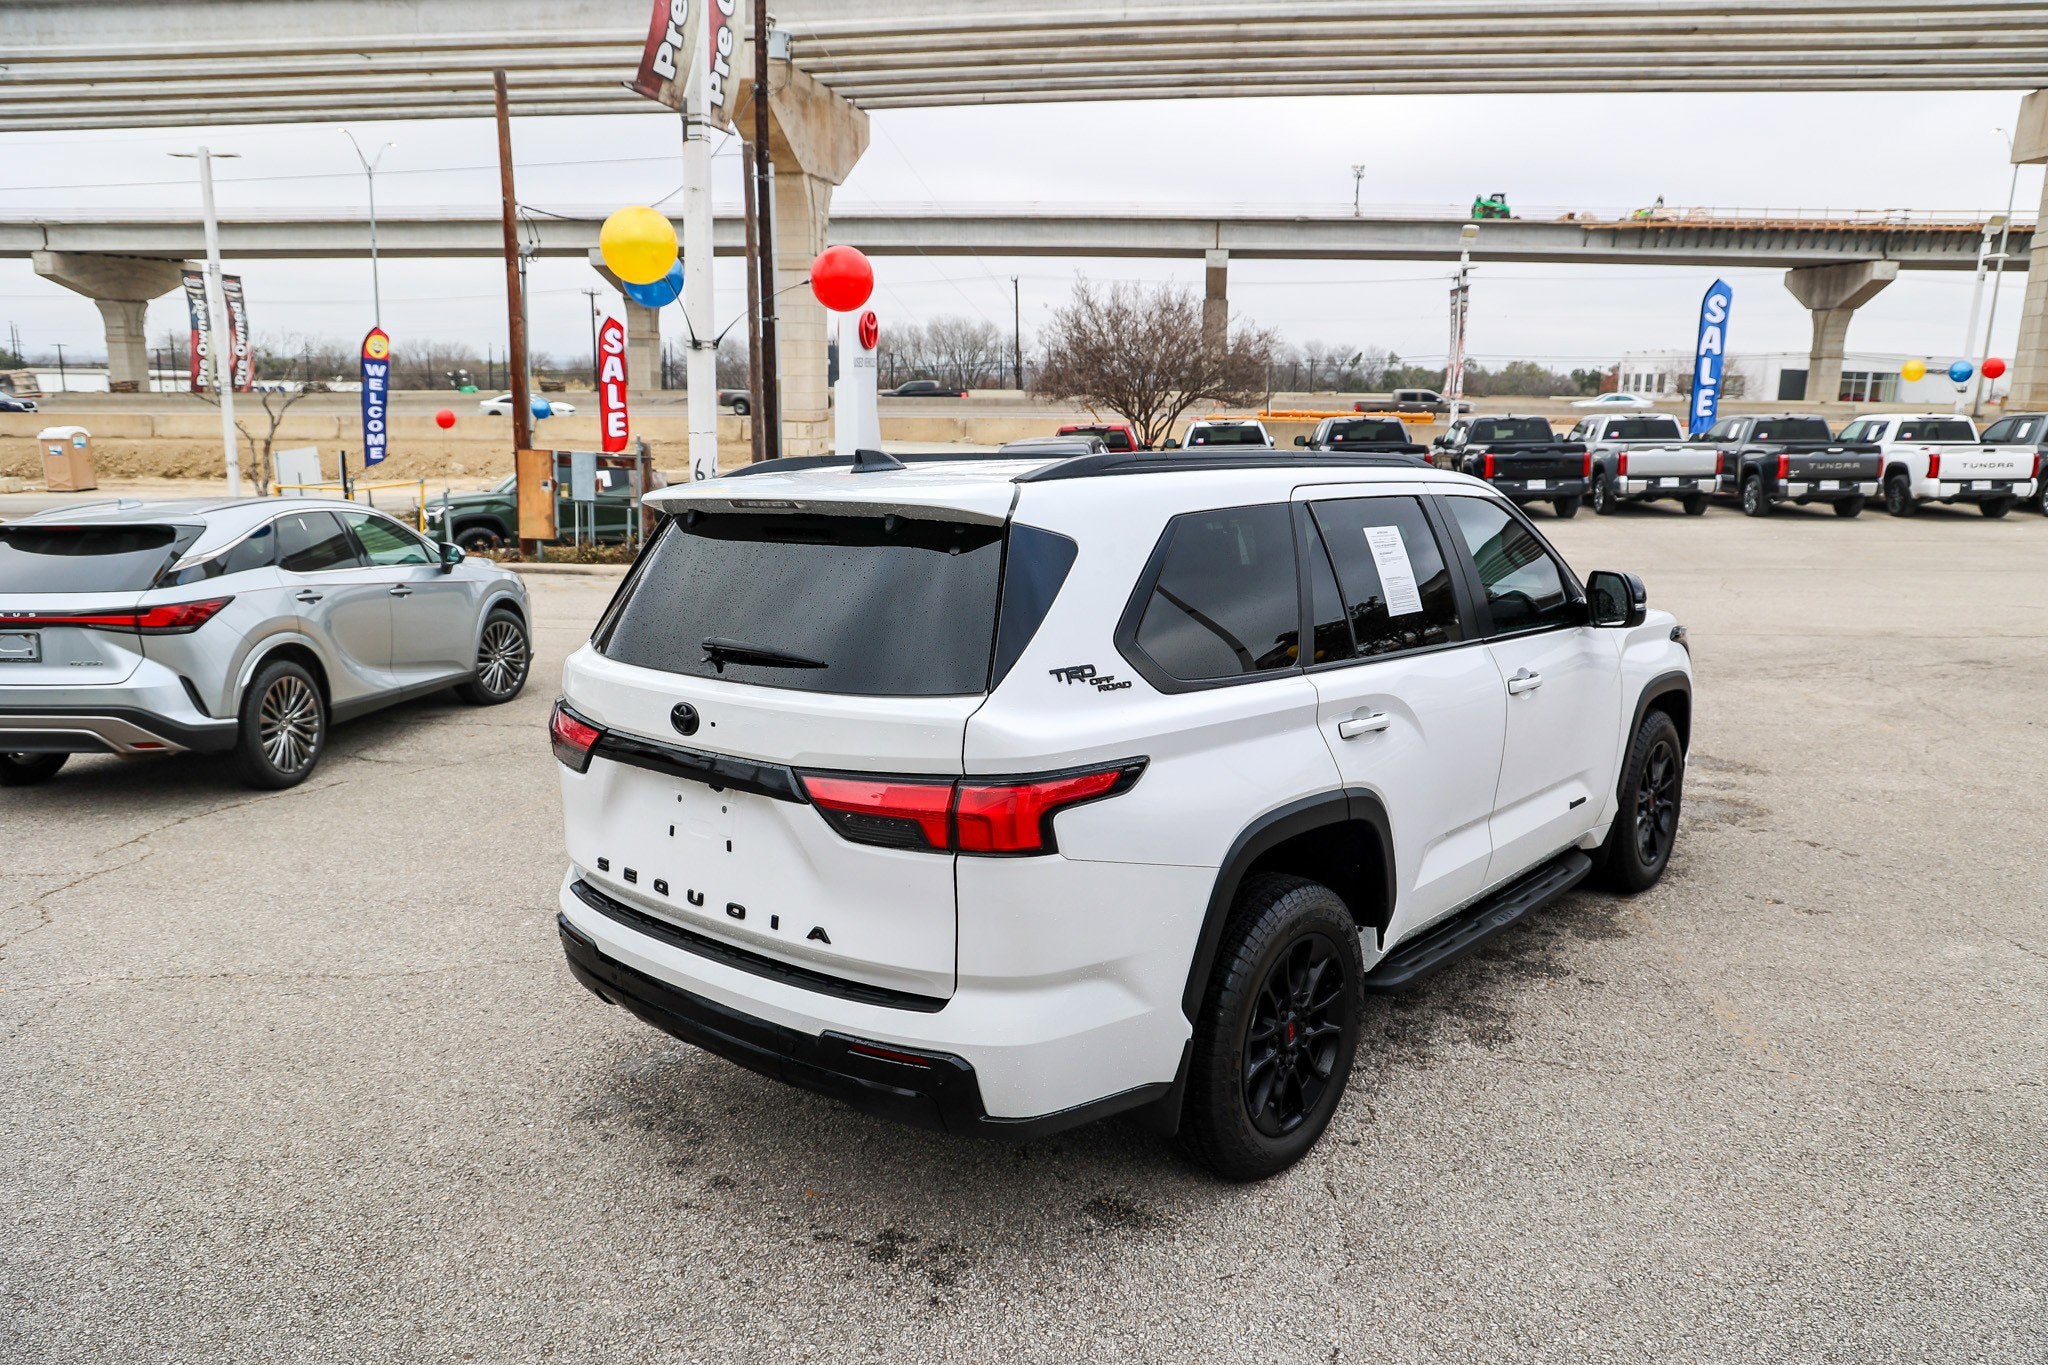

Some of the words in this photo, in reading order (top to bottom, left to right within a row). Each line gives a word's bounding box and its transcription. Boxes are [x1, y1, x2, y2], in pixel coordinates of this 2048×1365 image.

[652, 0, 689, 81] Pre
[709, 26, 733, 107] Pre
[601, 327, 627, 438] SALE
[1696, 294, 1728, 417] SALE
[364, 363, 387, 459] WELCOME
[1809, 462, 1861, 470] TUNDRA
[1962, 462, 2015, 470] TUNDRA
[1049, 664, 1097, 685] TRD
[1089, 675, 1115, 686] OFF
[1097, 680, 1133, 693] ROAD
[597, 857, 833, 945] SEQUOIA
